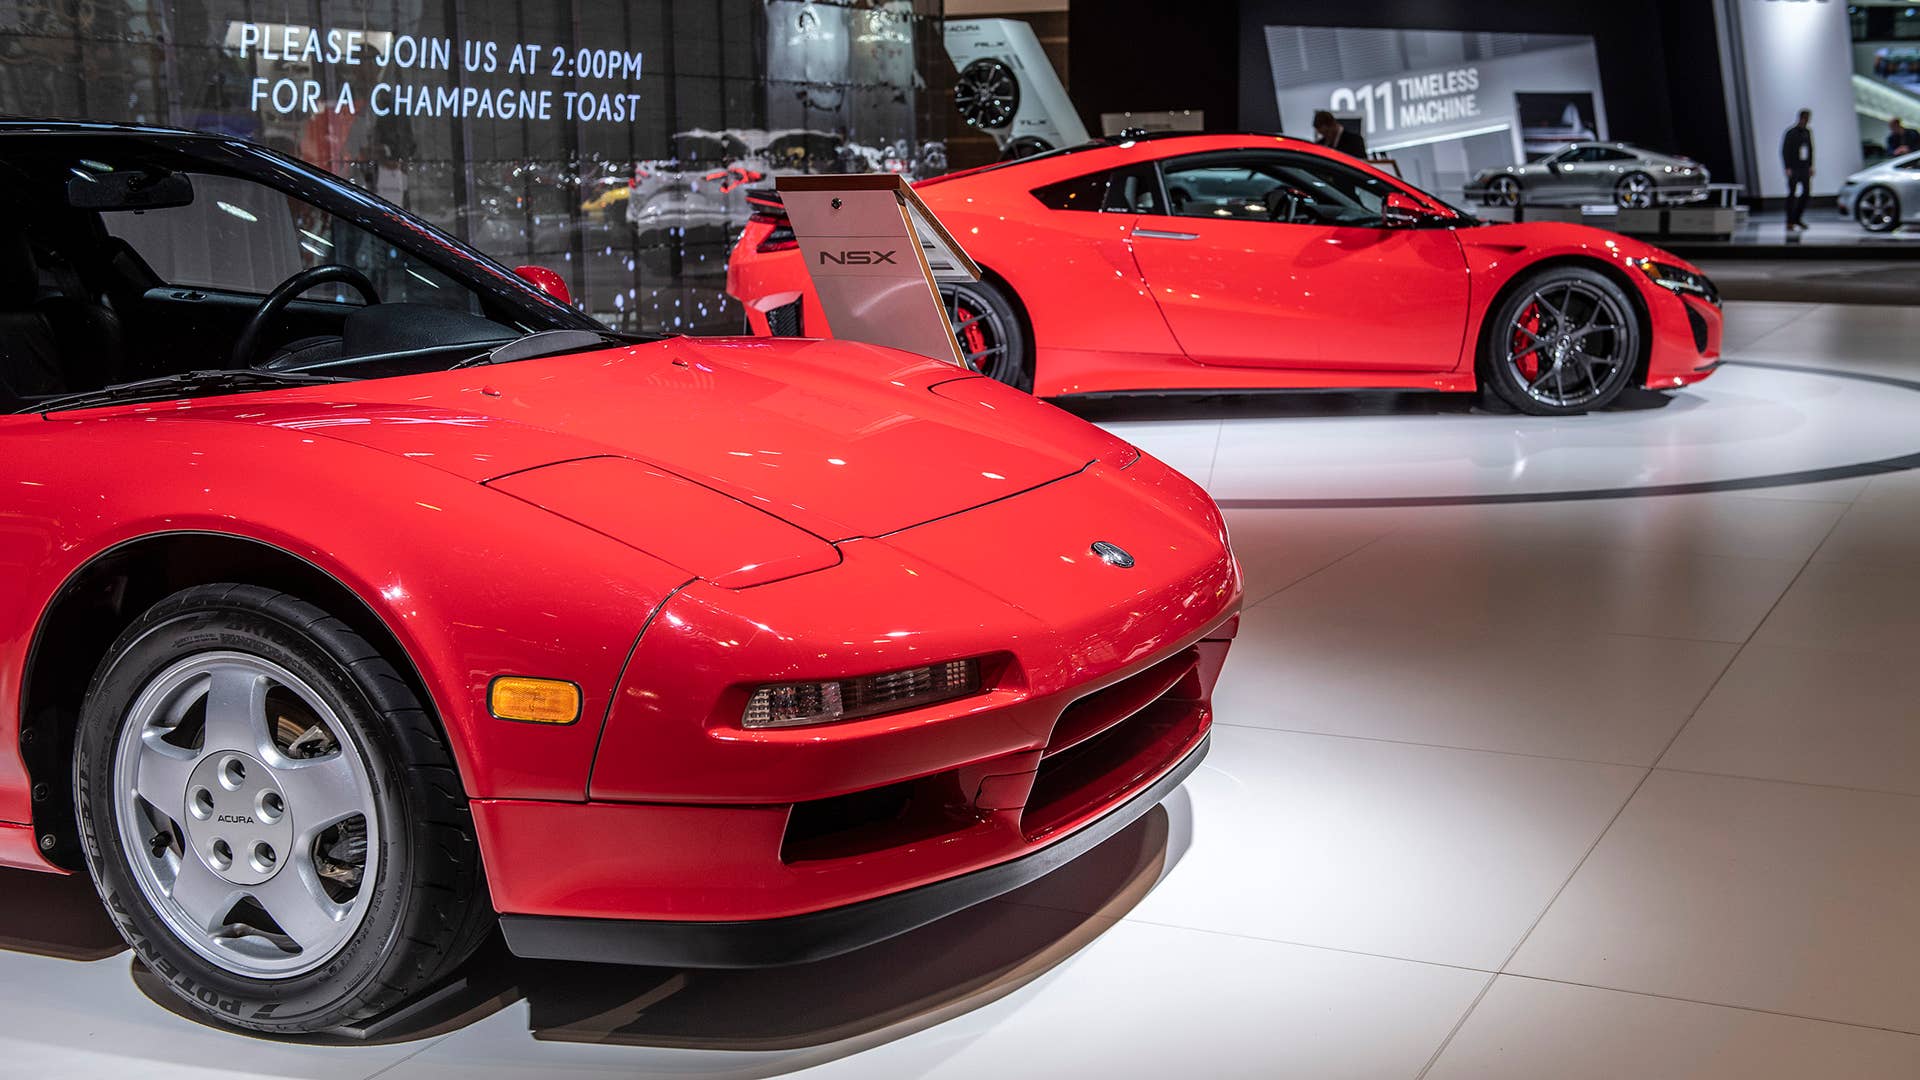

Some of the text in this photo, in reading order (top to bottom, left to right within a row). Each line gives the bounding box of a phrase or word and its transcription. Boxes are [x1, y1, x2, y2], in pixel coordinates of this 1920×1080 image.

[240, 23, 643, 81] PLEASE JOIN US AT 2:00PM
[251, 77, 641, 123] FOR A CHAMPAGNE TOAST
[1397, 67, 1480, 101] TIMELESS
[1399, 94, 1481, 129] MACHINE.
[819, 250, 897, 265] NSX
[217, 814, 255, 824] ACURA
[107, 890, 243, 1017] POTENZA
